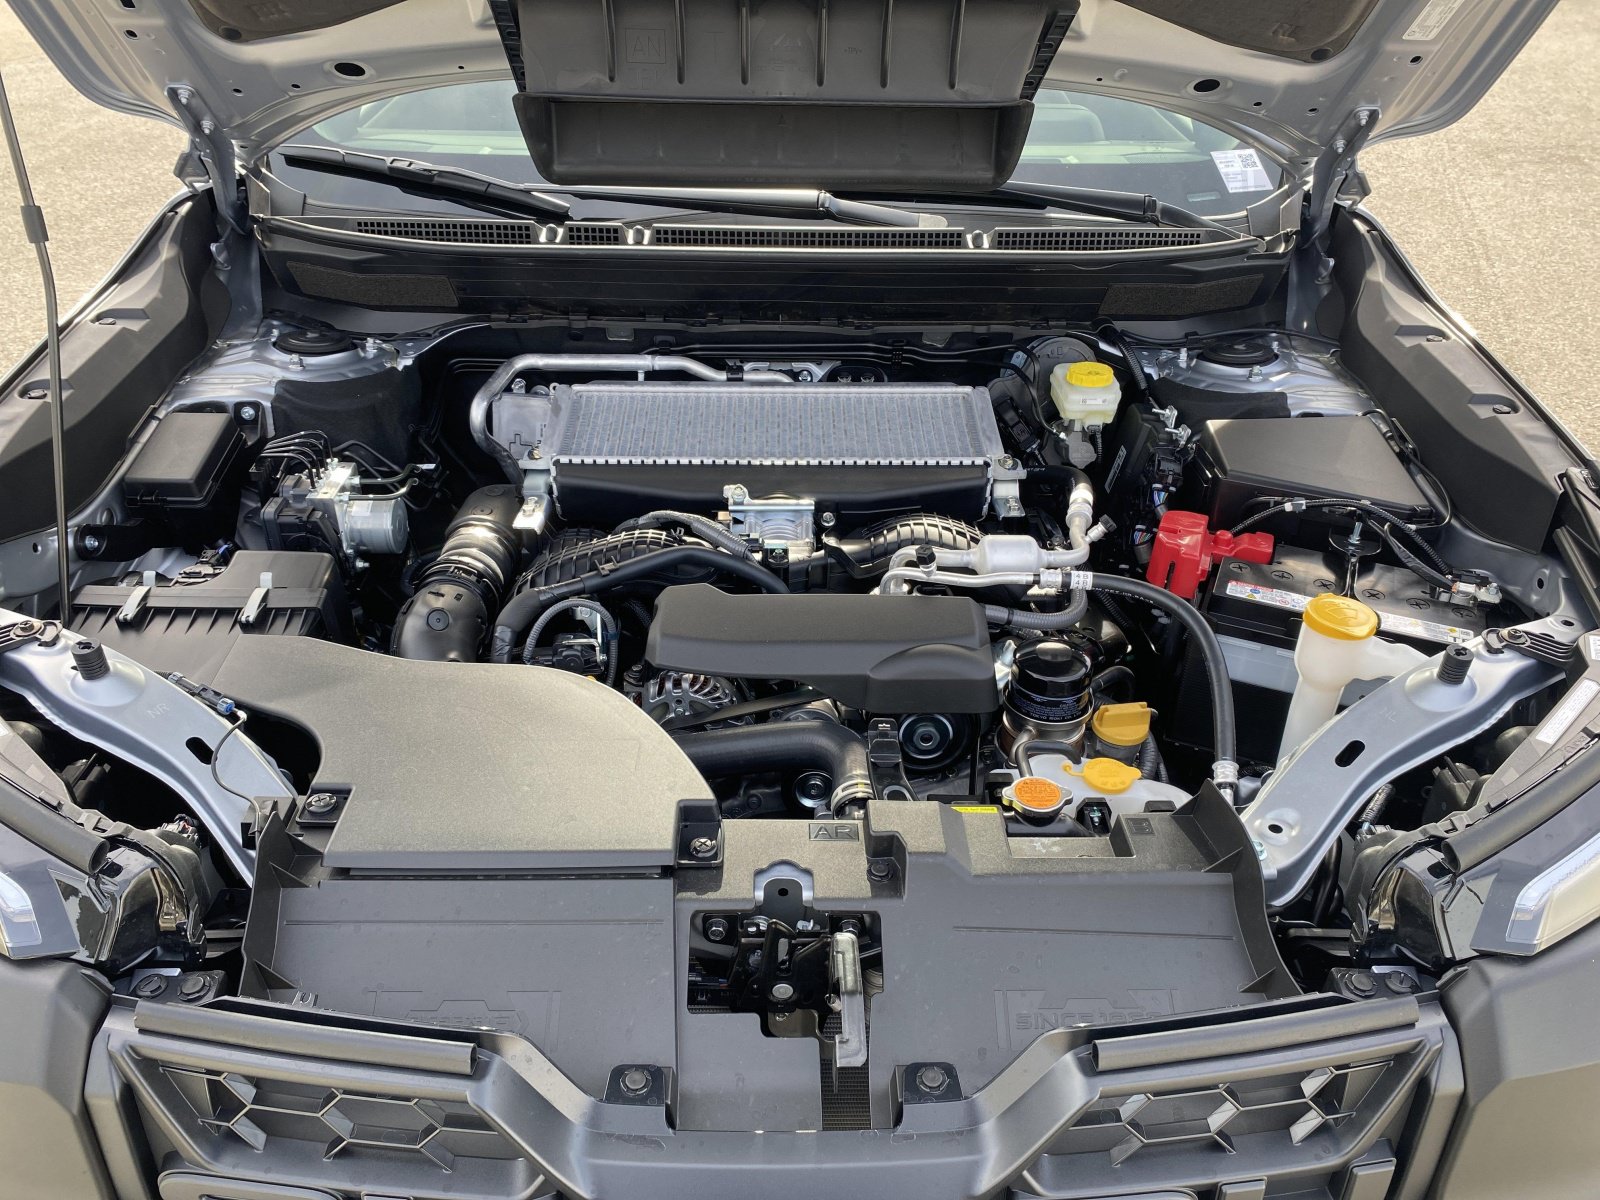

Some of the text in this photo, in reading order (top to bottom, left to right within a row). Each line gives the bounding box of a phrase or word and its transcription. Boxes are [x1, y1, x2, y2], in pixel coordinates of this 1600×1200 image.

[632, 36, 661, 56] AN
[1030, 712, 1048, 720] TOKYO
[813, 823, 856, 840] AR
[1015, 1012, 1093, 1030] SINCE
